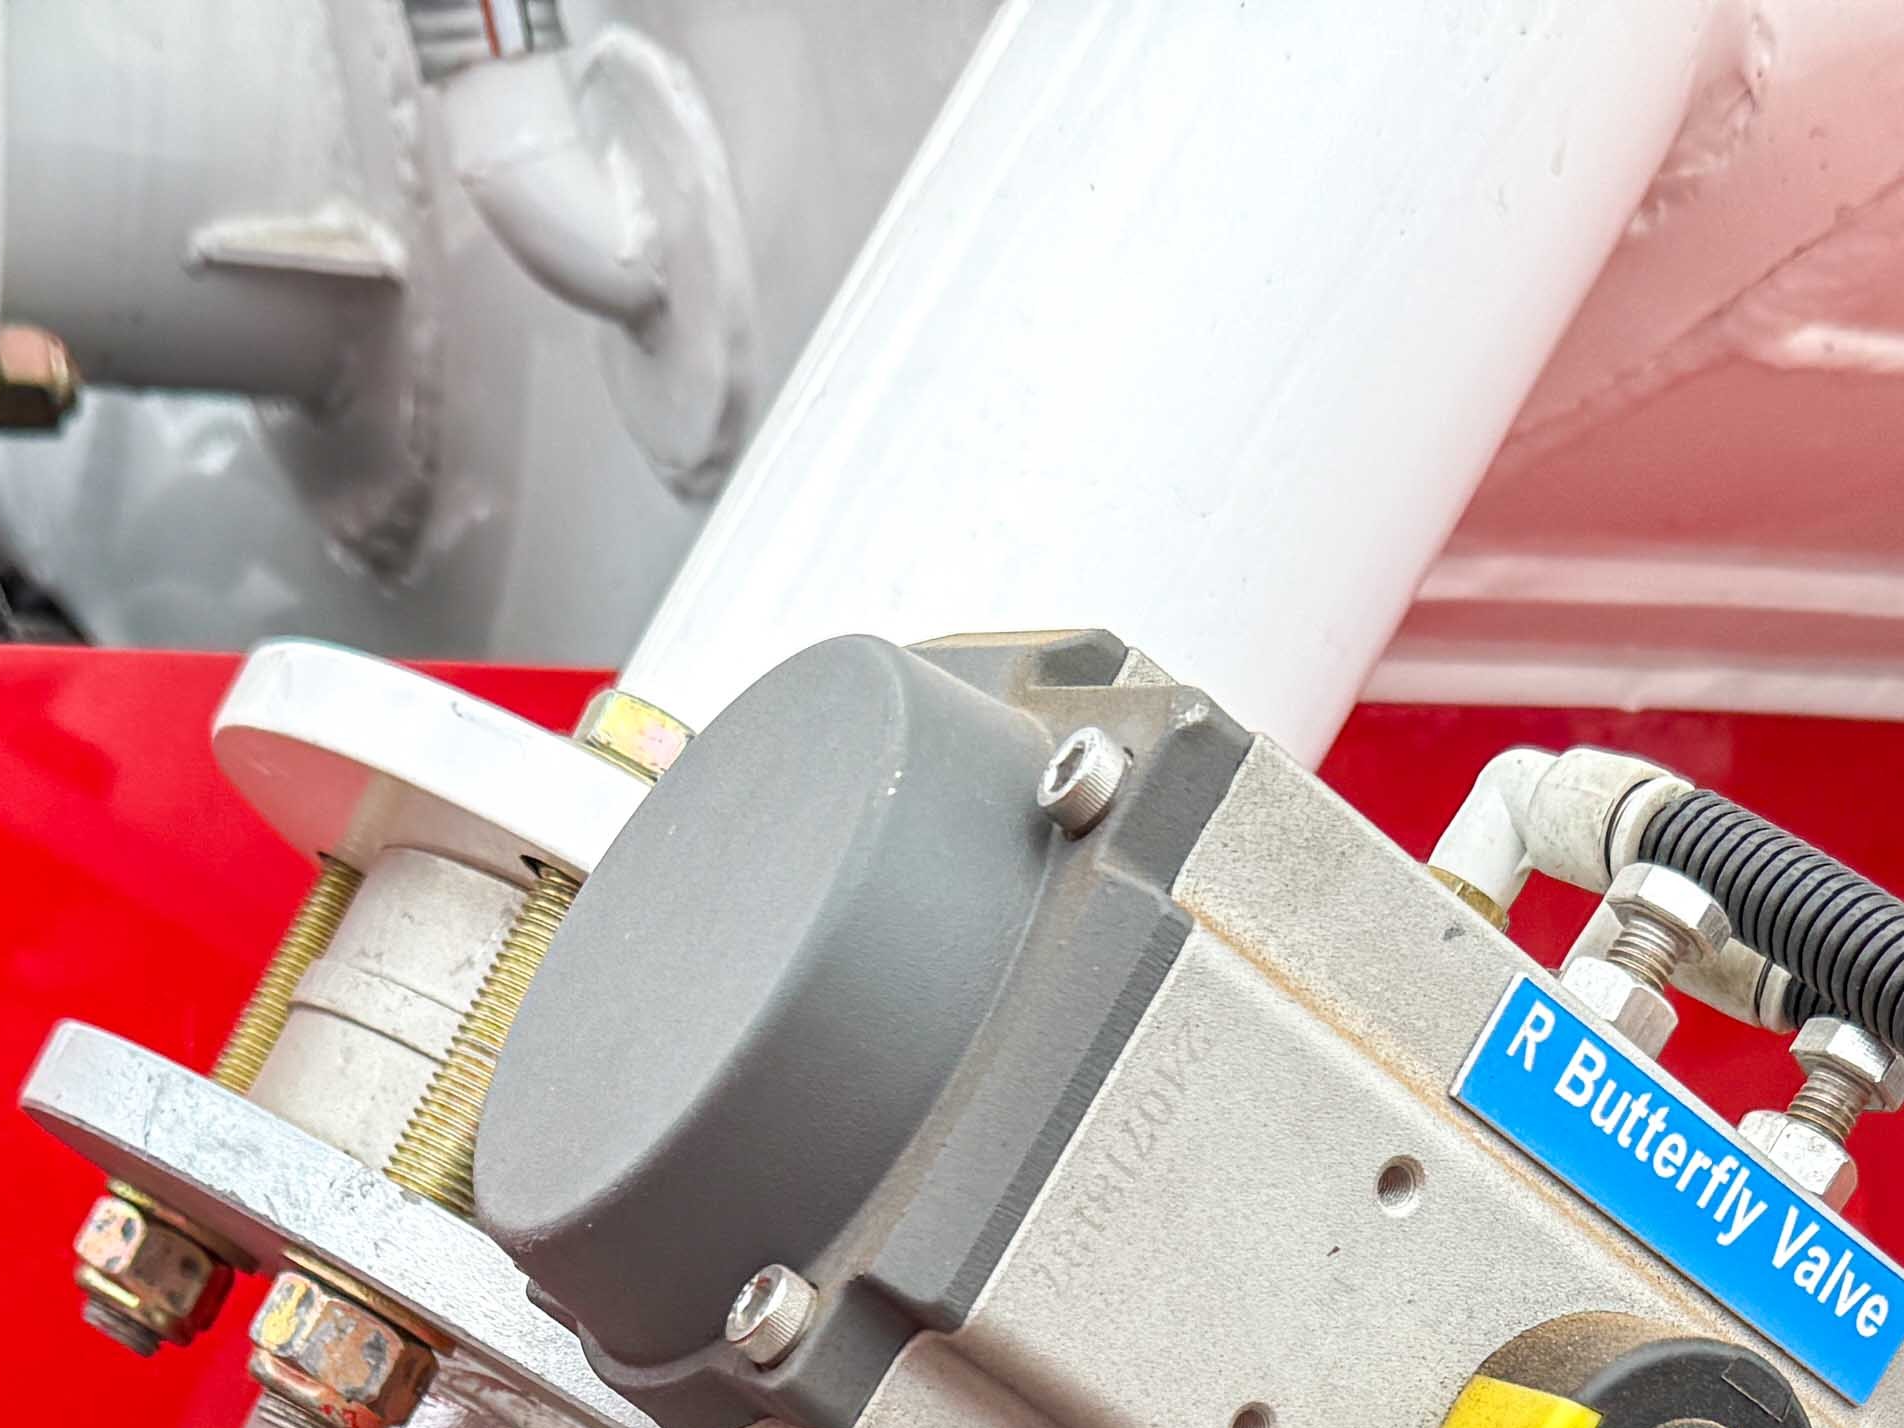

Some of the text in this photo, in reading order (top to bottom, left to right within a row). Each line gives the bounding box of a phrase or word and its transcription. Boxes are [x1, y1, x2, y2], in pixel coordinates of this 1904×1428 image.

[1506, 999, 1890, 1338] R Butterfly Valve
